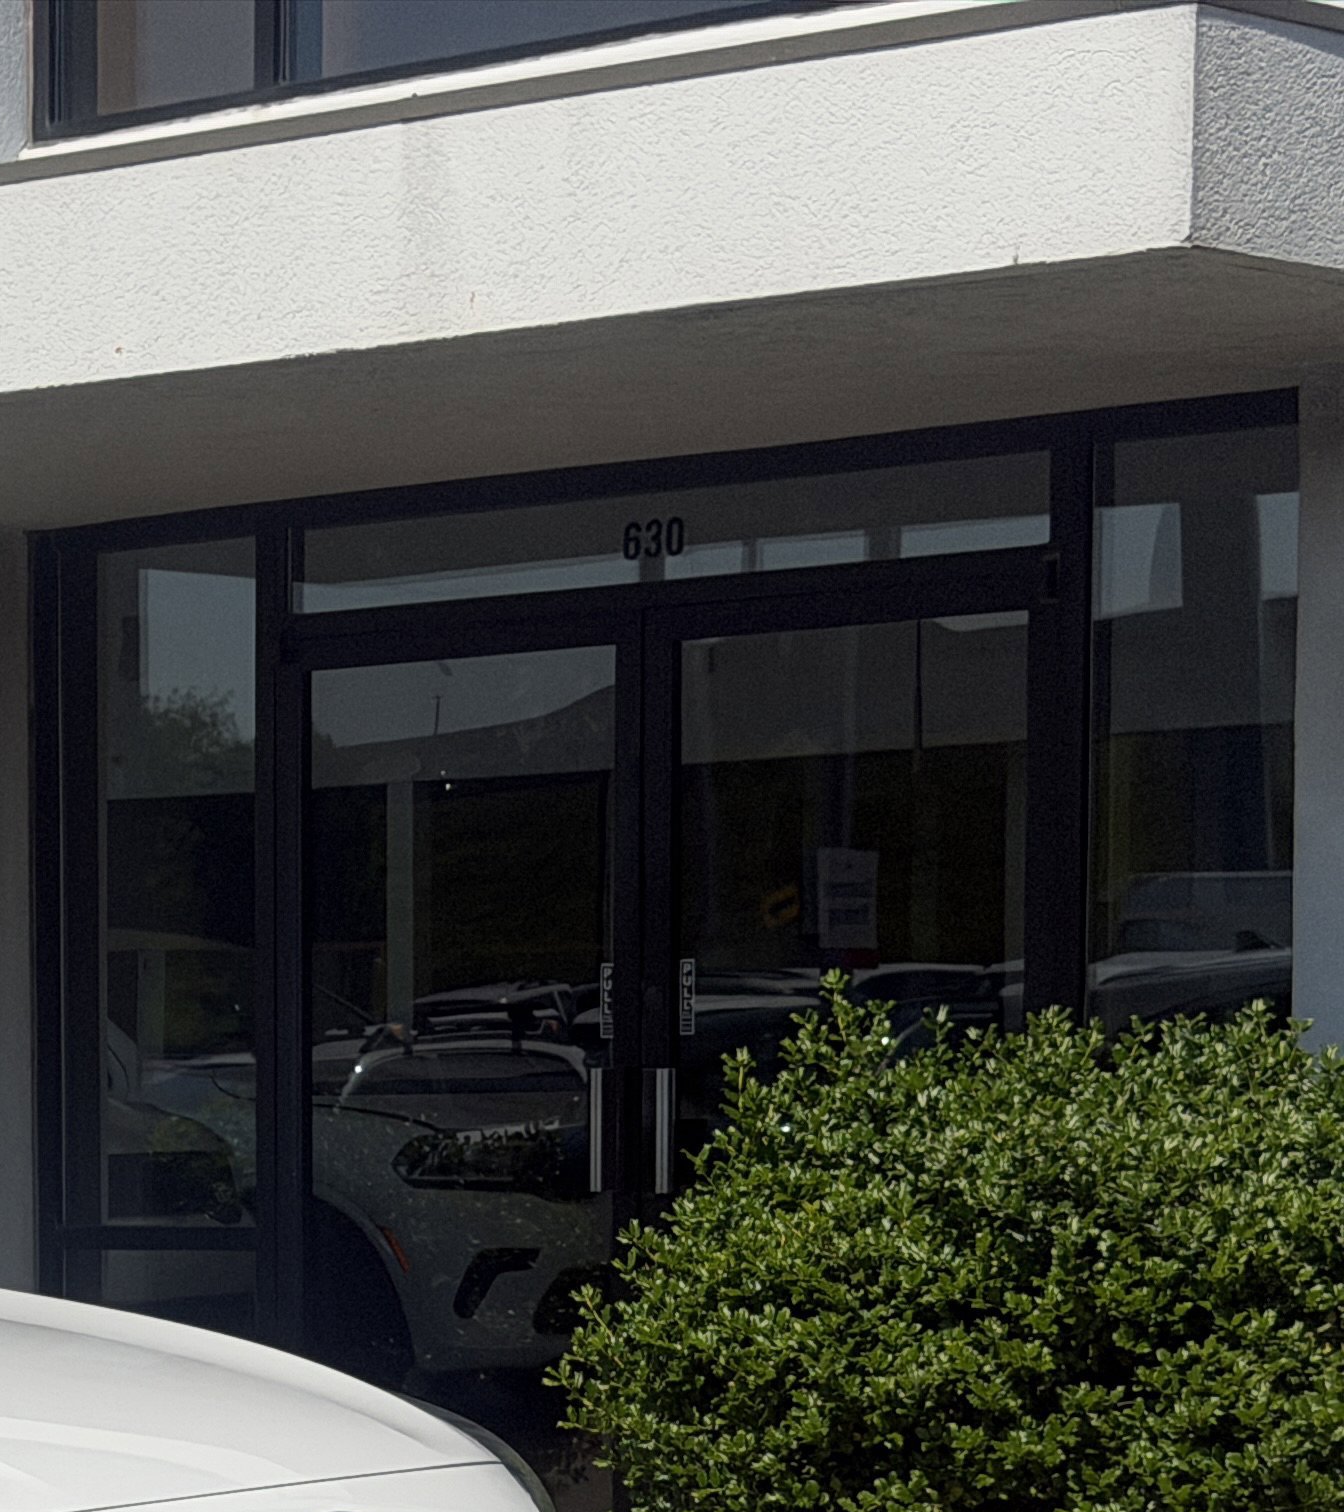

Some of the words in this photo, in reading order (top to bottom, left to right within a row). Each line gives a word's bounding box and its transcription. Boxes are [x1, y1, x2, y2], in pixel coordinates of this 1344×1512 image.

[623, 517, 684, 560] 630
[603, 967, 613, 1014] PULL
[682, 963, 692, 1011] PULL
